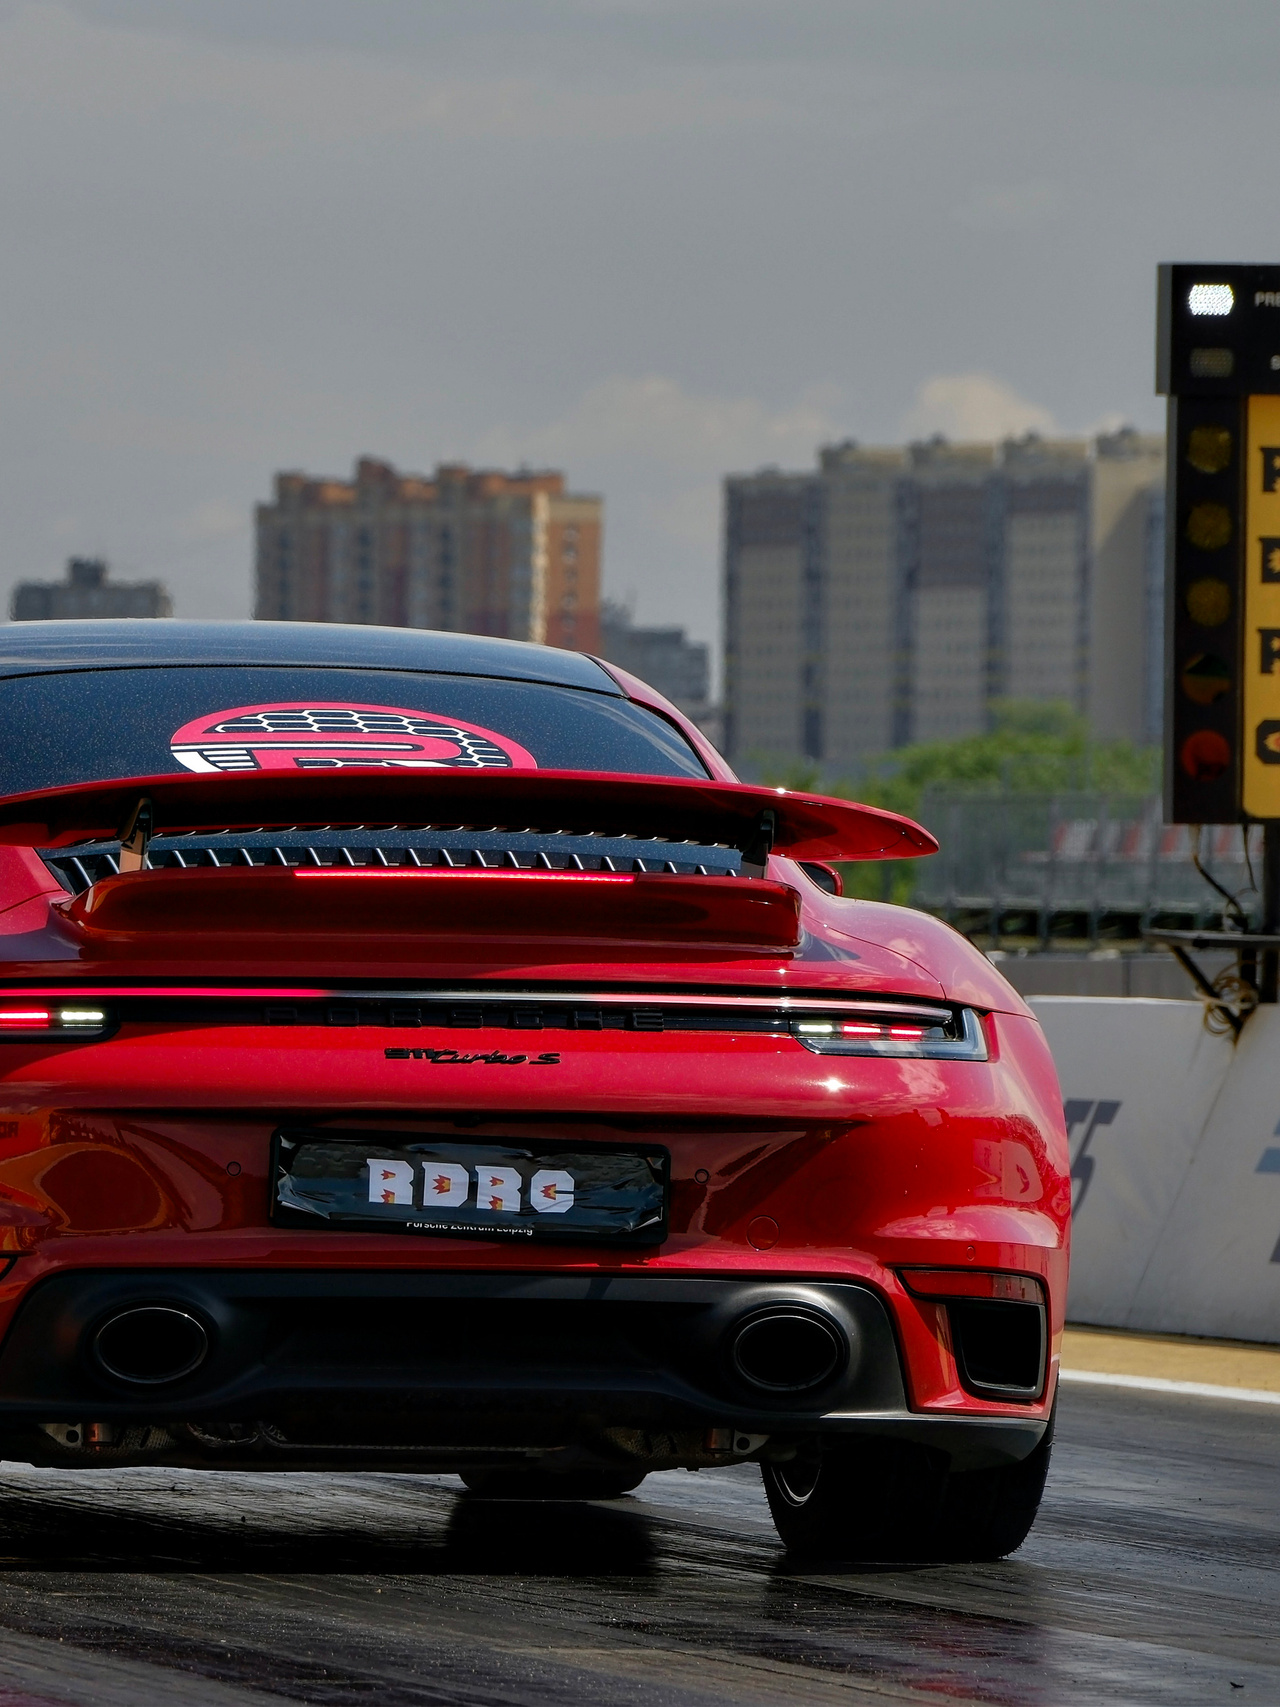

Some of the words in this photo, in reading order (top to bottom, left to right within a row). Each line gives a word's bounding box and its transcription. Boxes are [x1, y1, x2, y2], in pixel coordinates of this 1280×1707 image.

[263, 1006, 664, 1031] PORSCHE
[529, 1052, 562, 1065] S
[366, 1157, 576, 1214] RDRC
